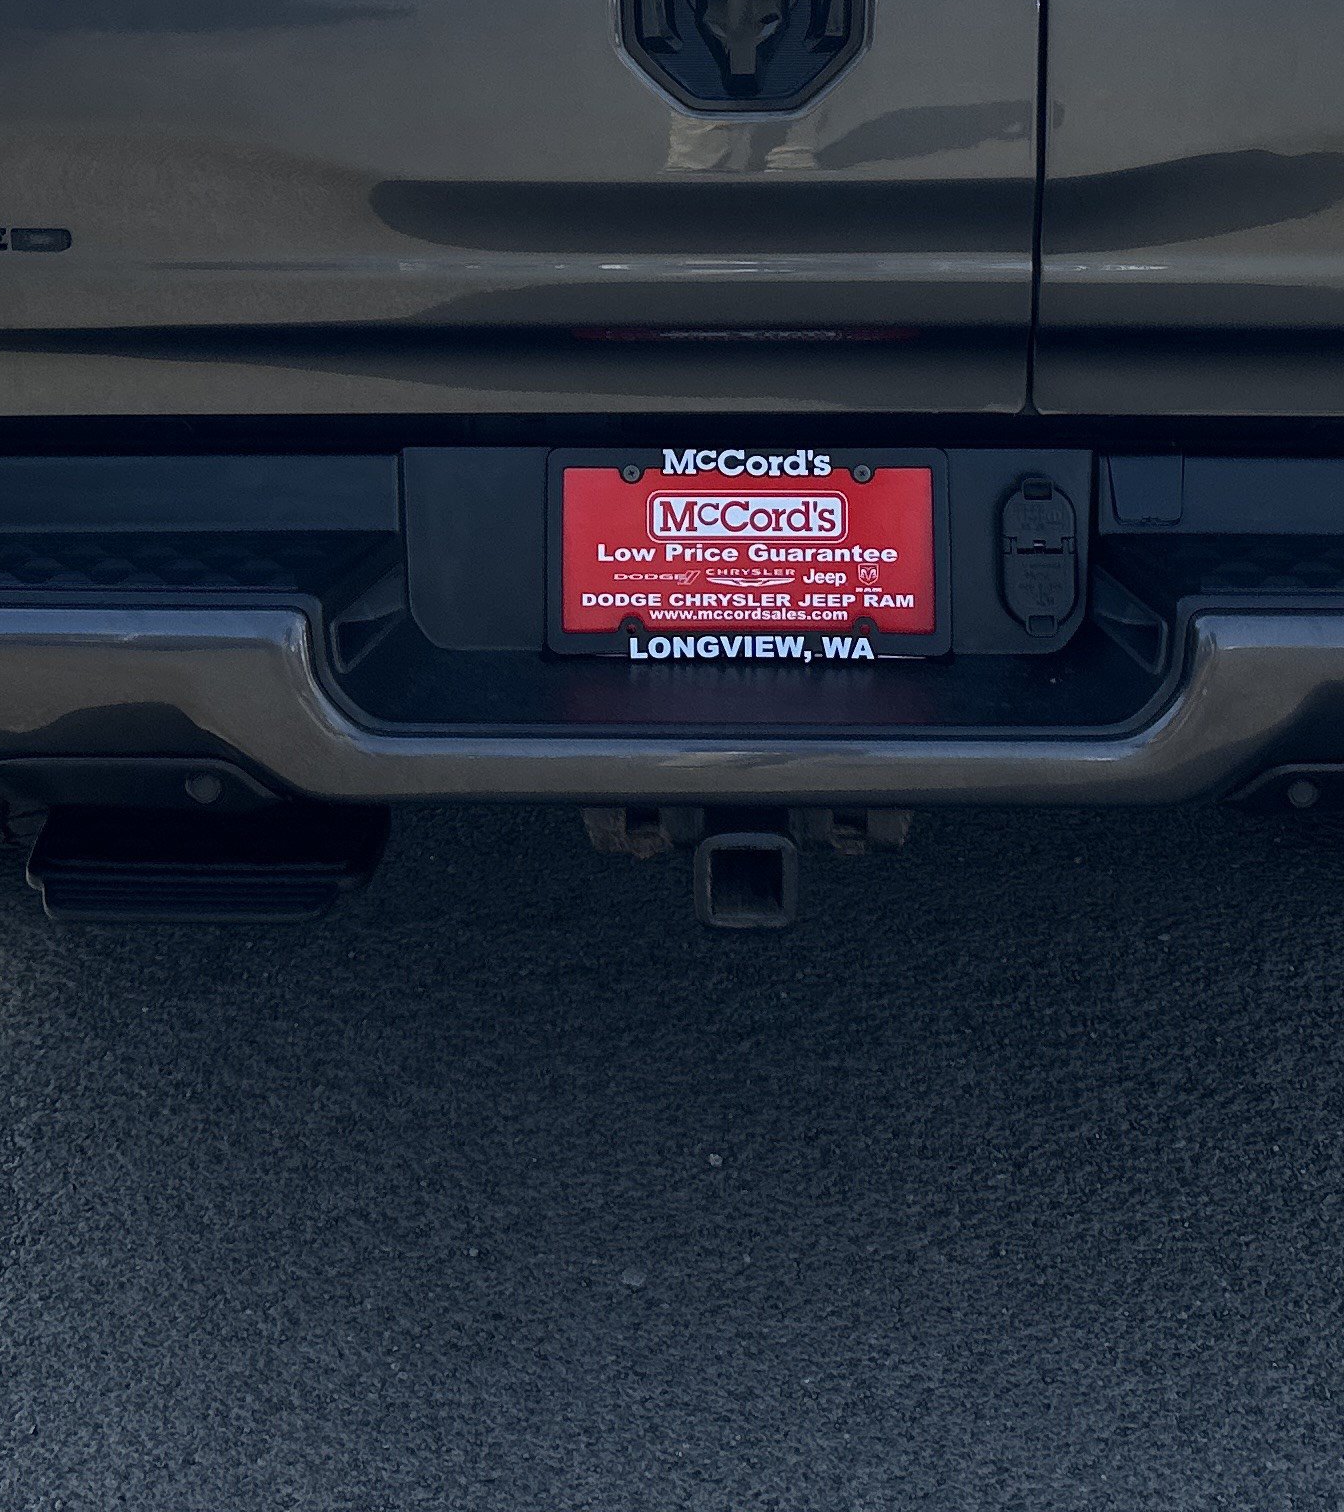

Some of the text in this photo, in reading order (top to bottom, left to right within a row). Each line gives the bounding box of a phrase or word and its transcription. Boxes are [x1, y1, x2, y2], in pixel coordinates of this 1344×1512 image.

[662, 448, 832, 476] McCord's
[658, 500, 836, 533] McCord's
[597, 543, 898, 563] Low Price Guarantee
[705, 568, 796, 576] CHRYSLER
[802, 569, 847, 587] Jeep
[582, 592, 915, 608] DODGE CHRYSLER JEEP RAM
[648, 608, 848, 621] www.mccordsales.com
[630, 636, 875, 663] LONGVIEW, WA
